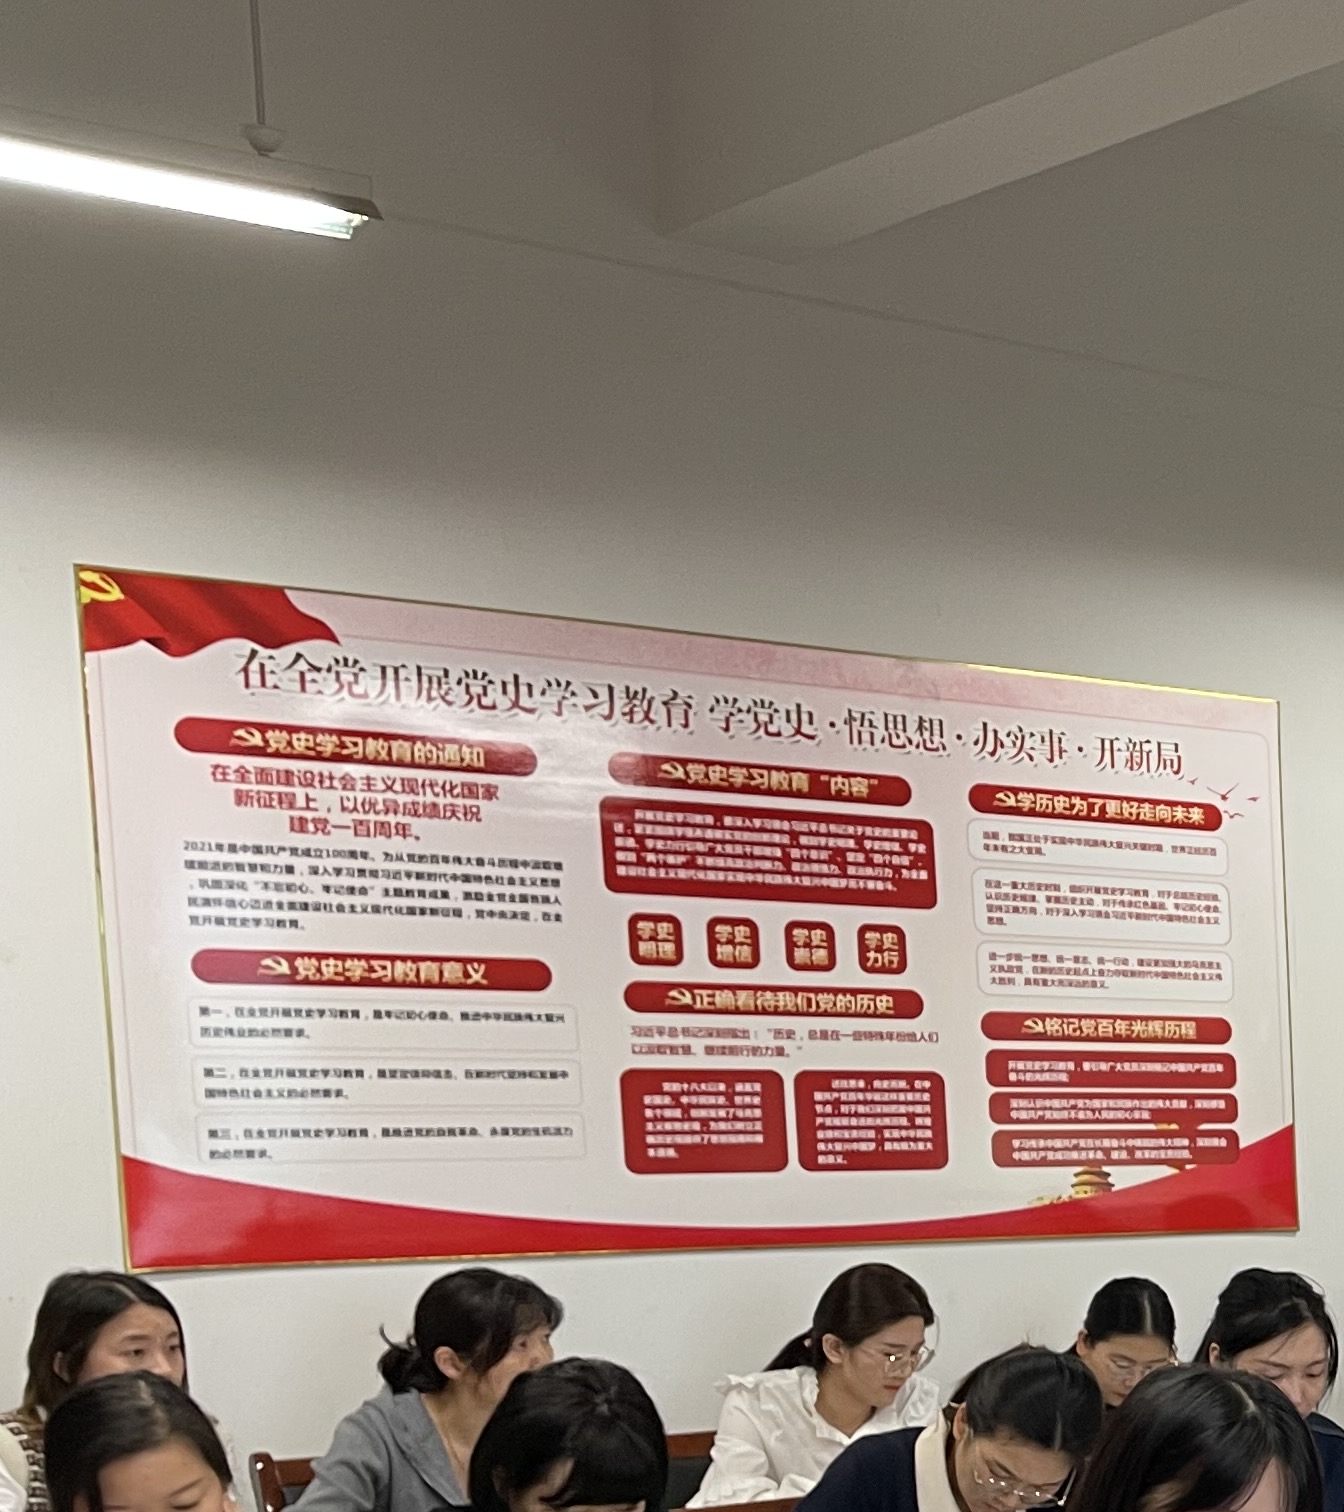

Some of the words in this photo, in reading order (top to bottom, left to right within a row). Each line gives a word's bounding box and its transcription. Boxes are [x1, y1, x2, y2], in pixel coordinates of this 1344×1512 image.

[235, 648, 695, 731] 在全党开展党史学习教育
[265, 729, 485, 767] 党史学习教育的通知
[211, 764, 500, 800] 在全面建设社会主义现代化国家
[233, 788, 482, 822] 新征程上，以优异成绩庆祝
[1017, 791, 1205, 825] 学历史为了更好走向未来
[289, 815, 421, 841] 建党一百周年。
[637, 921, 676, 941] 学史
[714, 924, 752, 943] 学史
[792, 928, 828, 947] 学史
[864, 931, 899, 949] 学史
[294, 956, 488, 985] 党史学习教育意义
[866, 950, 899, 968] 力行
[693, 988, 895, 1015] 正确看待我们党的历史
[1044, 1017, 1197, 1040] 铭记党百年光辉历程
